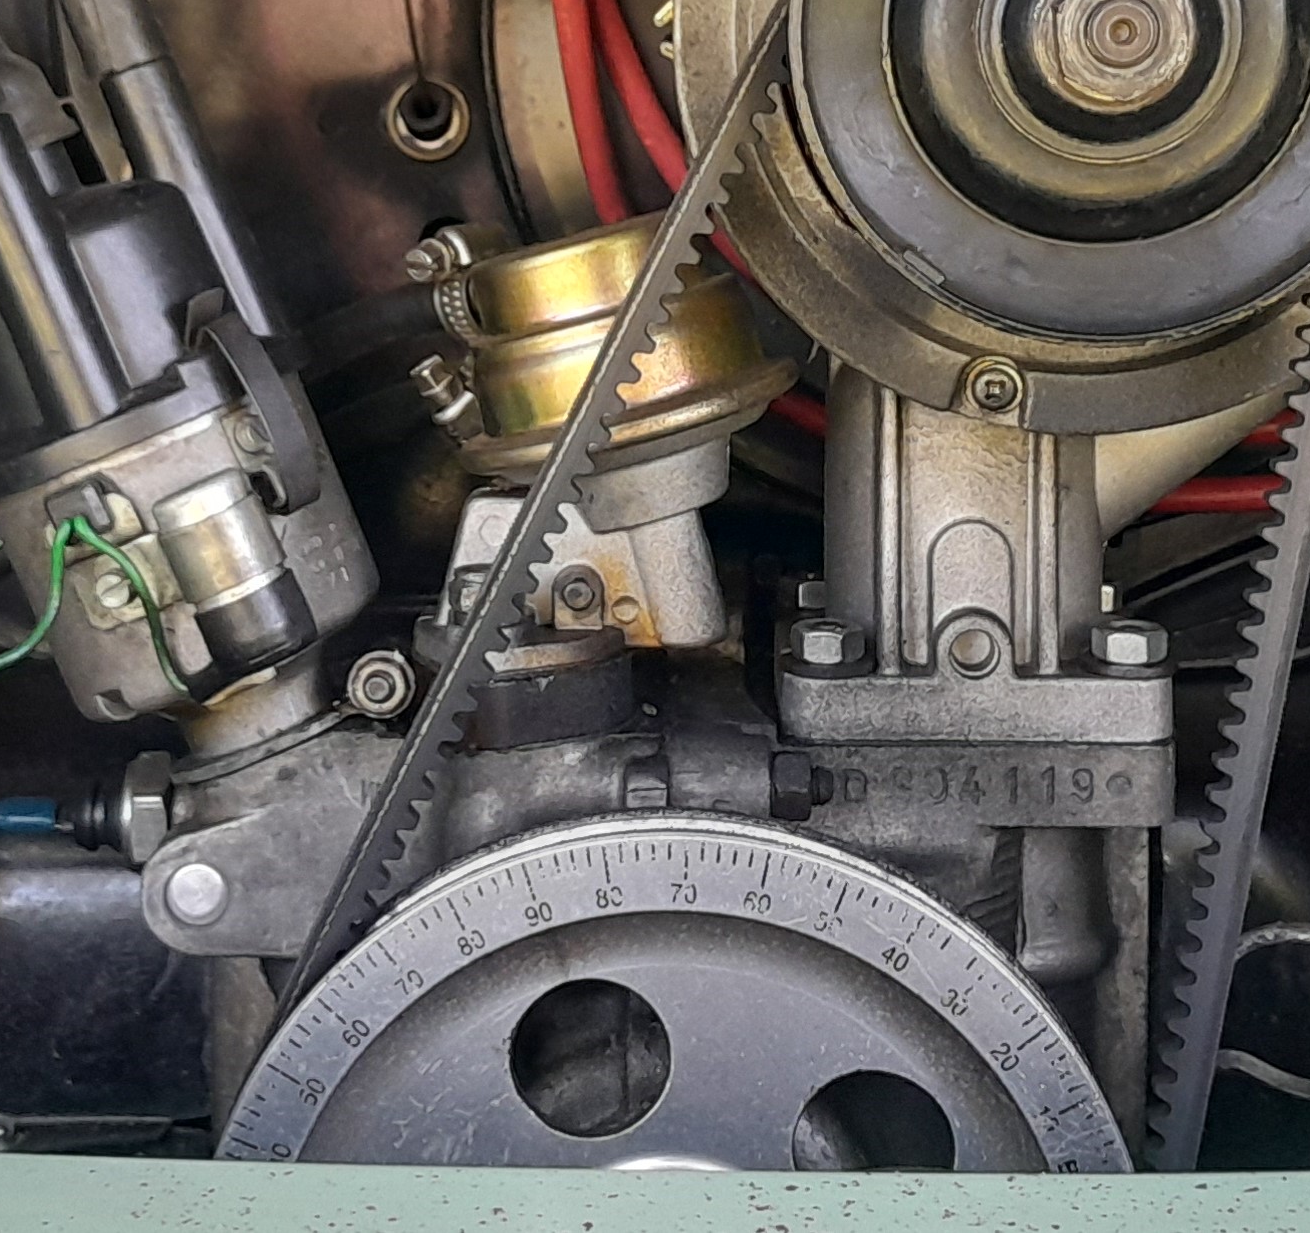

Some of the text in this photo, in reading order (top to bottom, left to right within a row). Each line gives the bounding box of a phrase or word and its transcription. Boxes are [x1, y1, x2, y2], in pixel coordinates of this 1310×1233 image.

[299, 1078, 327, 1107] 50
[342, 1018, 371, 1049] 60
[394, 969, 425, 997] 70
[457, 929, 486, 957] 80
[524, 903, 554, 928] 90
[595, 886, 624, 909] 80
[670, 883, 697, 905] 70
[743, 892, 772, 915] 60
[880, 946, 910, 973] 40
[939, 988, 970, 1017] 30
[989, 1042, 1019, 1072] 20
